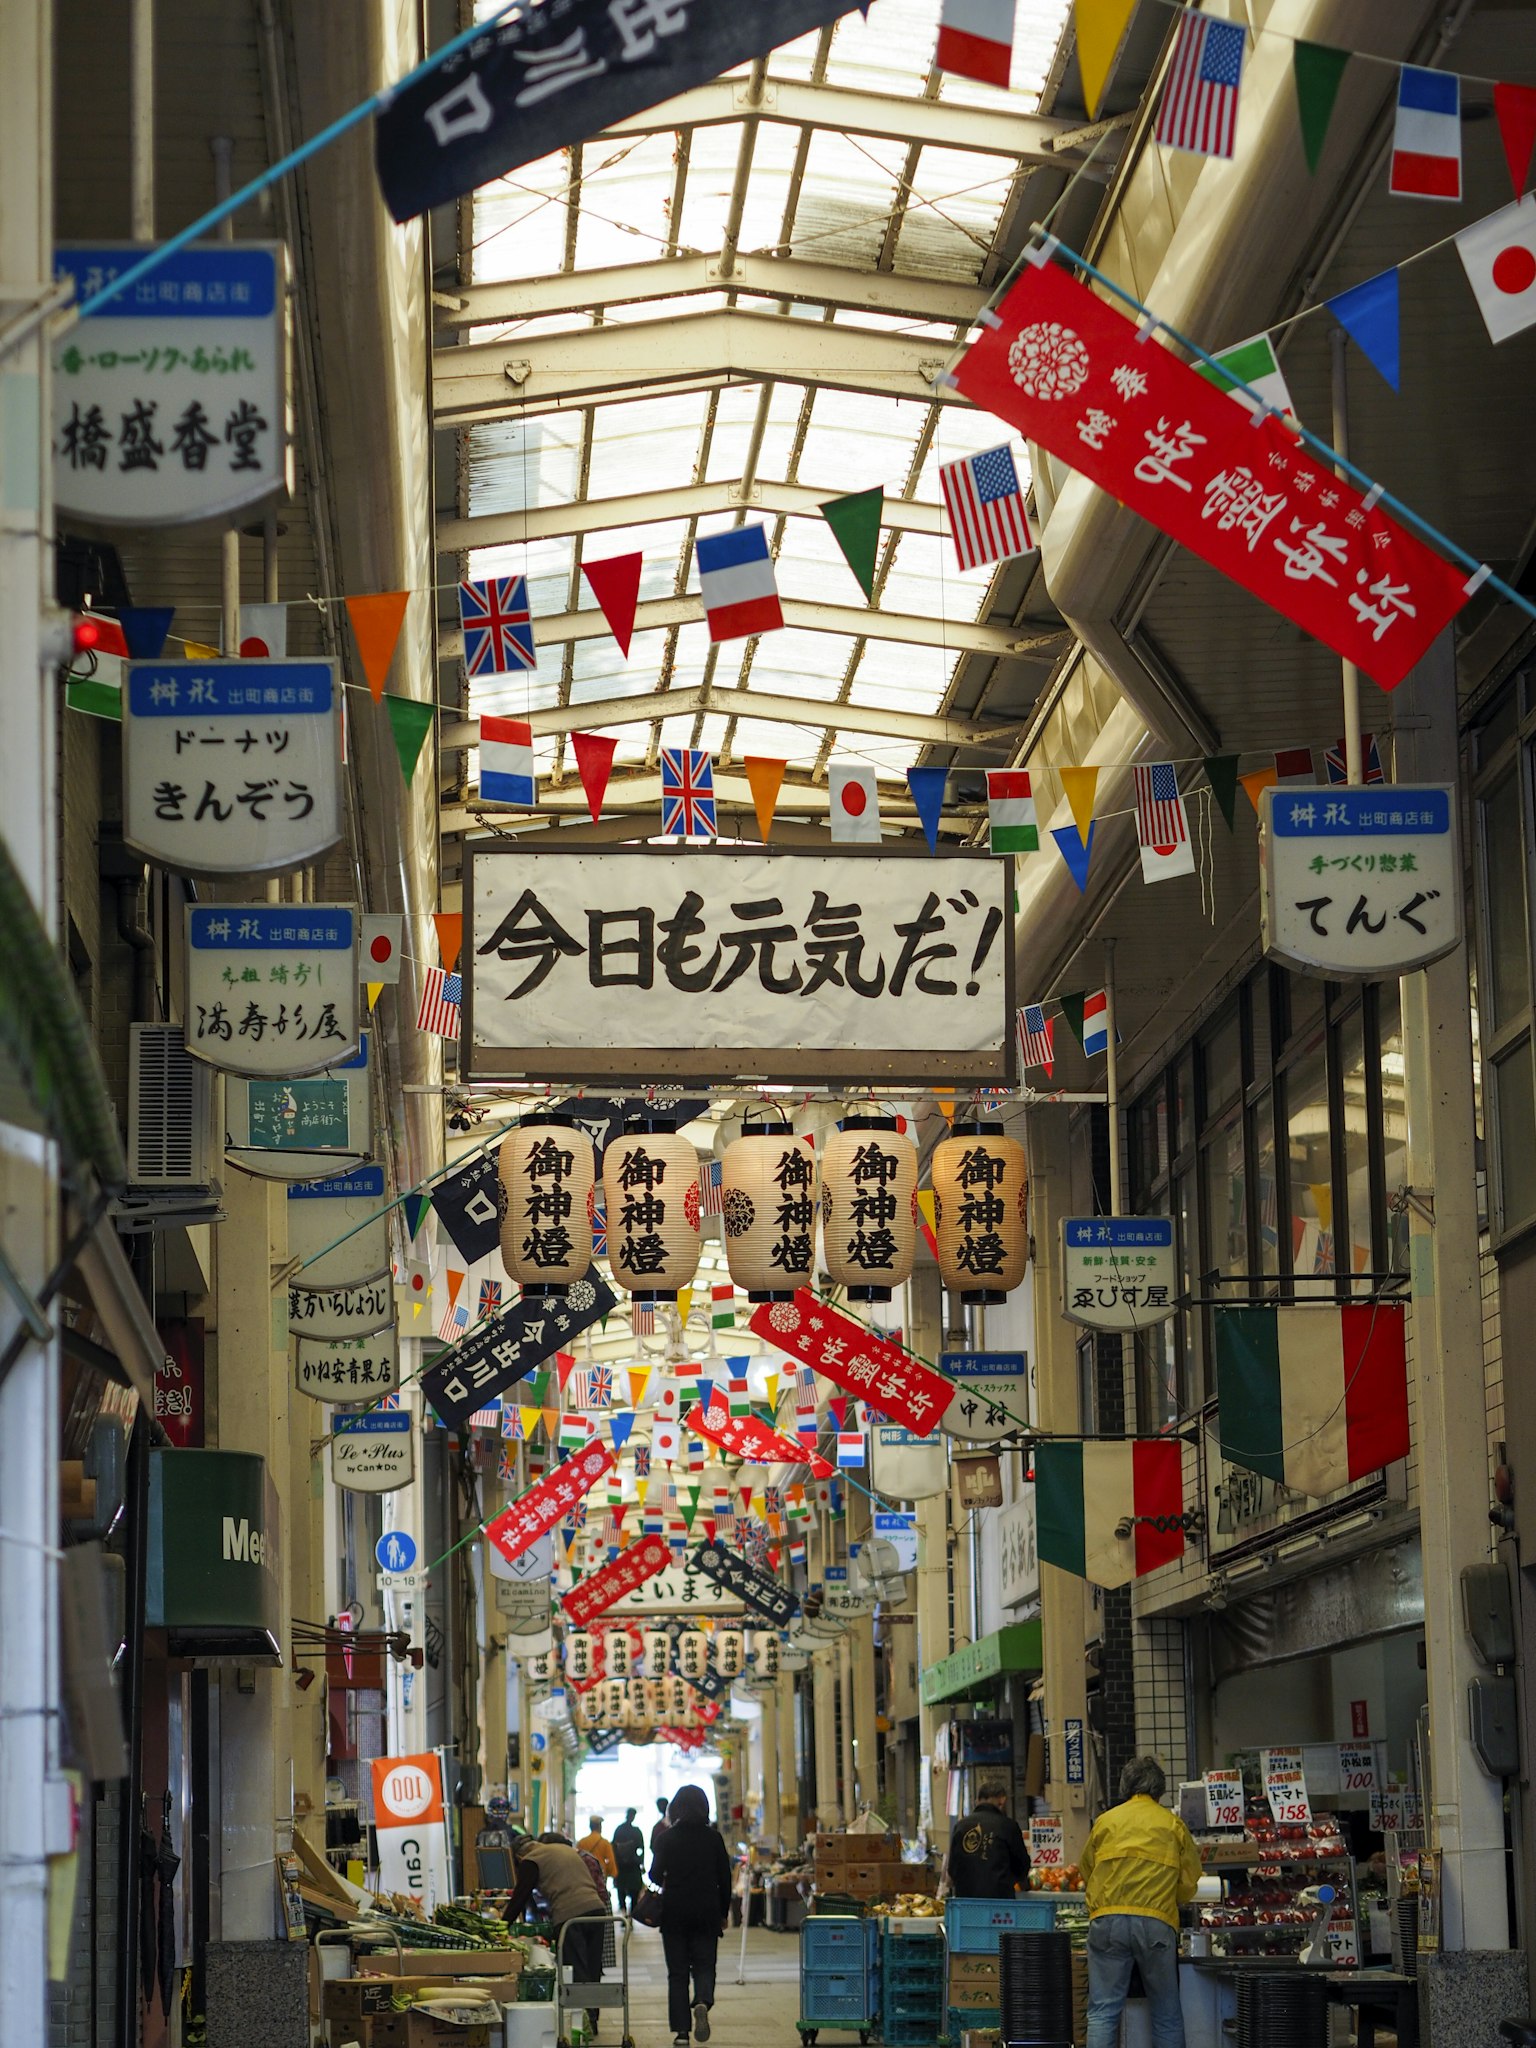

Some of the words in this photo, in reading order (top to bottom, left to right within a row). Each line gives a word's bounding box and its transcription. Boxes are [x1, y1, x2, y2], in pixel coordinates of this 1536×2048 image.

[135, 280, 250, 302] 出町商店街
[227, 688, 314, 705] 出町商店街
[175, 729, 289, 754] ドーナツ
[152, 778, 315, 821] きんぞう
[1359, 812, 1433, 826] 出町商店街
[1308, 853, 1418, 875] 手づくり惣菜
[1295, 890, 1440, 937] てんぐ
[269, 928, 338, 942] 出町商店街
[221, 965, 261, 985] 元祖
[302, 1100, 335, 1112] ようこそ
[301, 1115, 343, 1127] 商店街へ
[323, 1181, 374, 1192] 出町商店街
[521, 1137, 575, 1268] 御神燈
[617, 1147, 670, 1276] 御神燈
[769, 1148, 813, 1274] 御神燈
[847, 1142, 899, 1270] 御神燈
[954, 1146, 1009, 1276] 御神燈
[1118, 1232, 1162, 1242] 出町商店街
[1094, 1274, 1146, 1282] フードショップ
[1072, 1286, 1170, 1309] ゑびす屋
[303, 1357, 391, 1385] かね安青果店
[444, 1319, 545, 1403] 今出川口
[960, 1399, 1008, 1428] 中村
[1066, 1721, 1082, 1780] 防カメラ作動中
[1342, 1757, 1372, 1768] 小松菜
[1346, 1772, 1373, 1790] 100
[1272, 1789, 1304, 1801] トマト
[1215, 1806, 1240, 1824] 198
[1279, 1804, 1307, 1820] 158
[1033, 1848, 1061, 1864] 298
